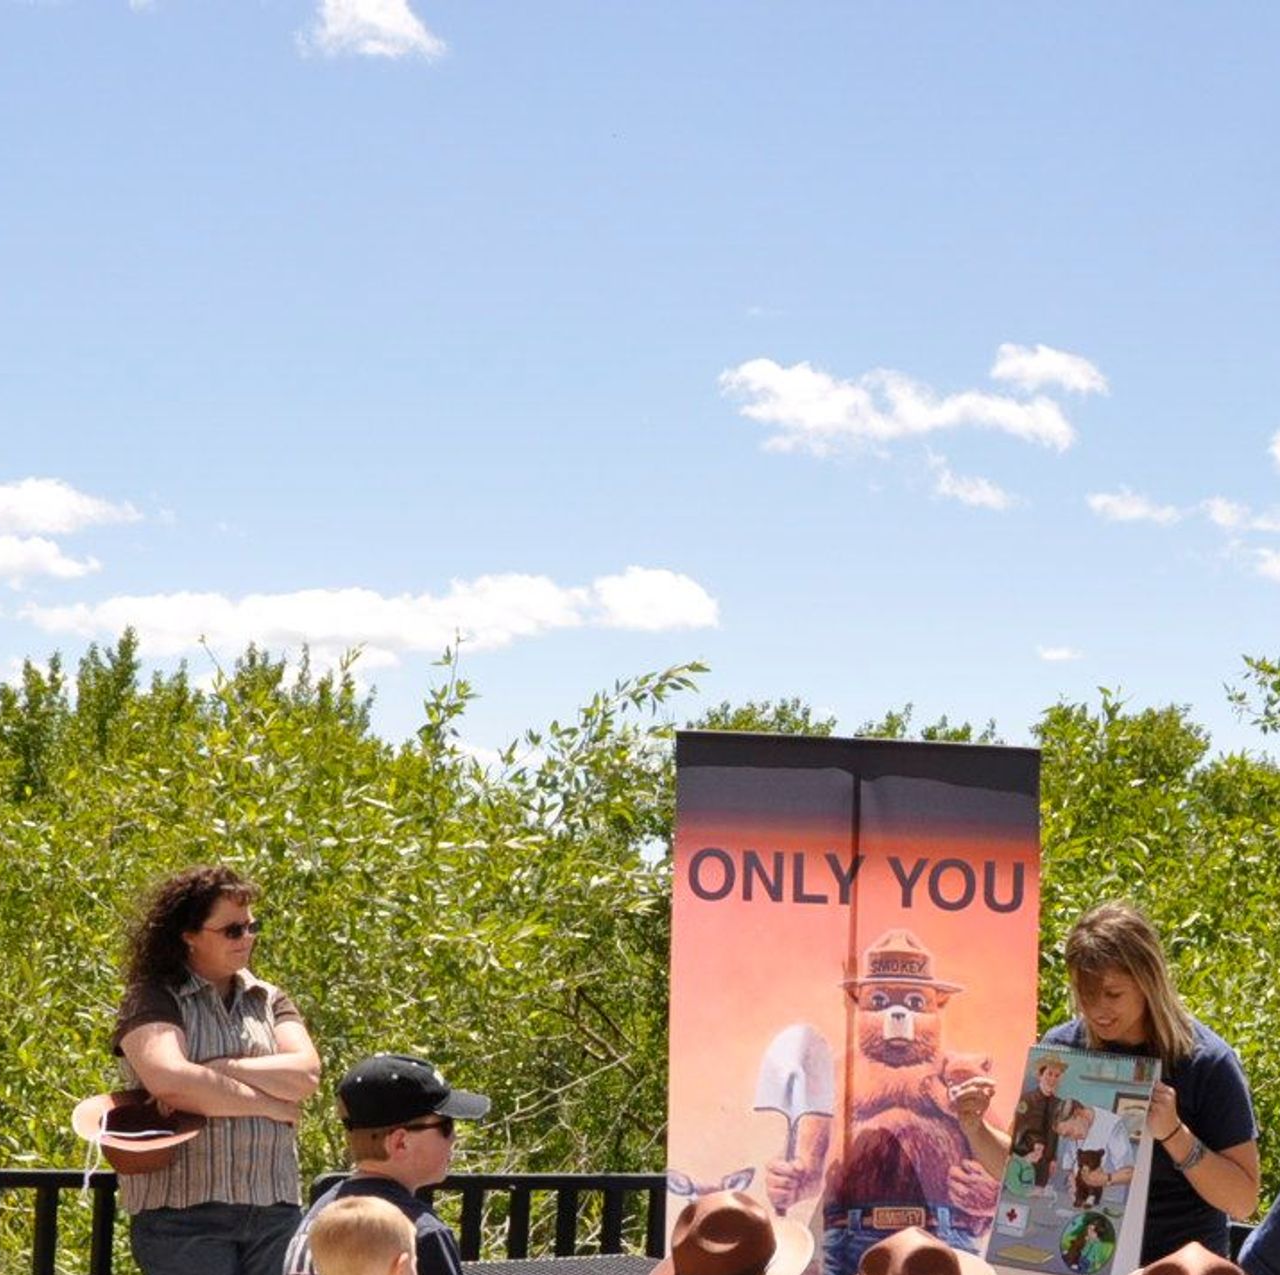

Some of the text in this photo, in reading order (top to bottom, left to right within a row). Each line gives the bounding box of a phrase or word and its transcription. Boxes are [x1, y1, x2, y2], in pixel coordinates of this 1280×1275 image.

[688, 847, 1025, 914] ONLY YOU
[870, 959, 927, 974] SMOKEY
